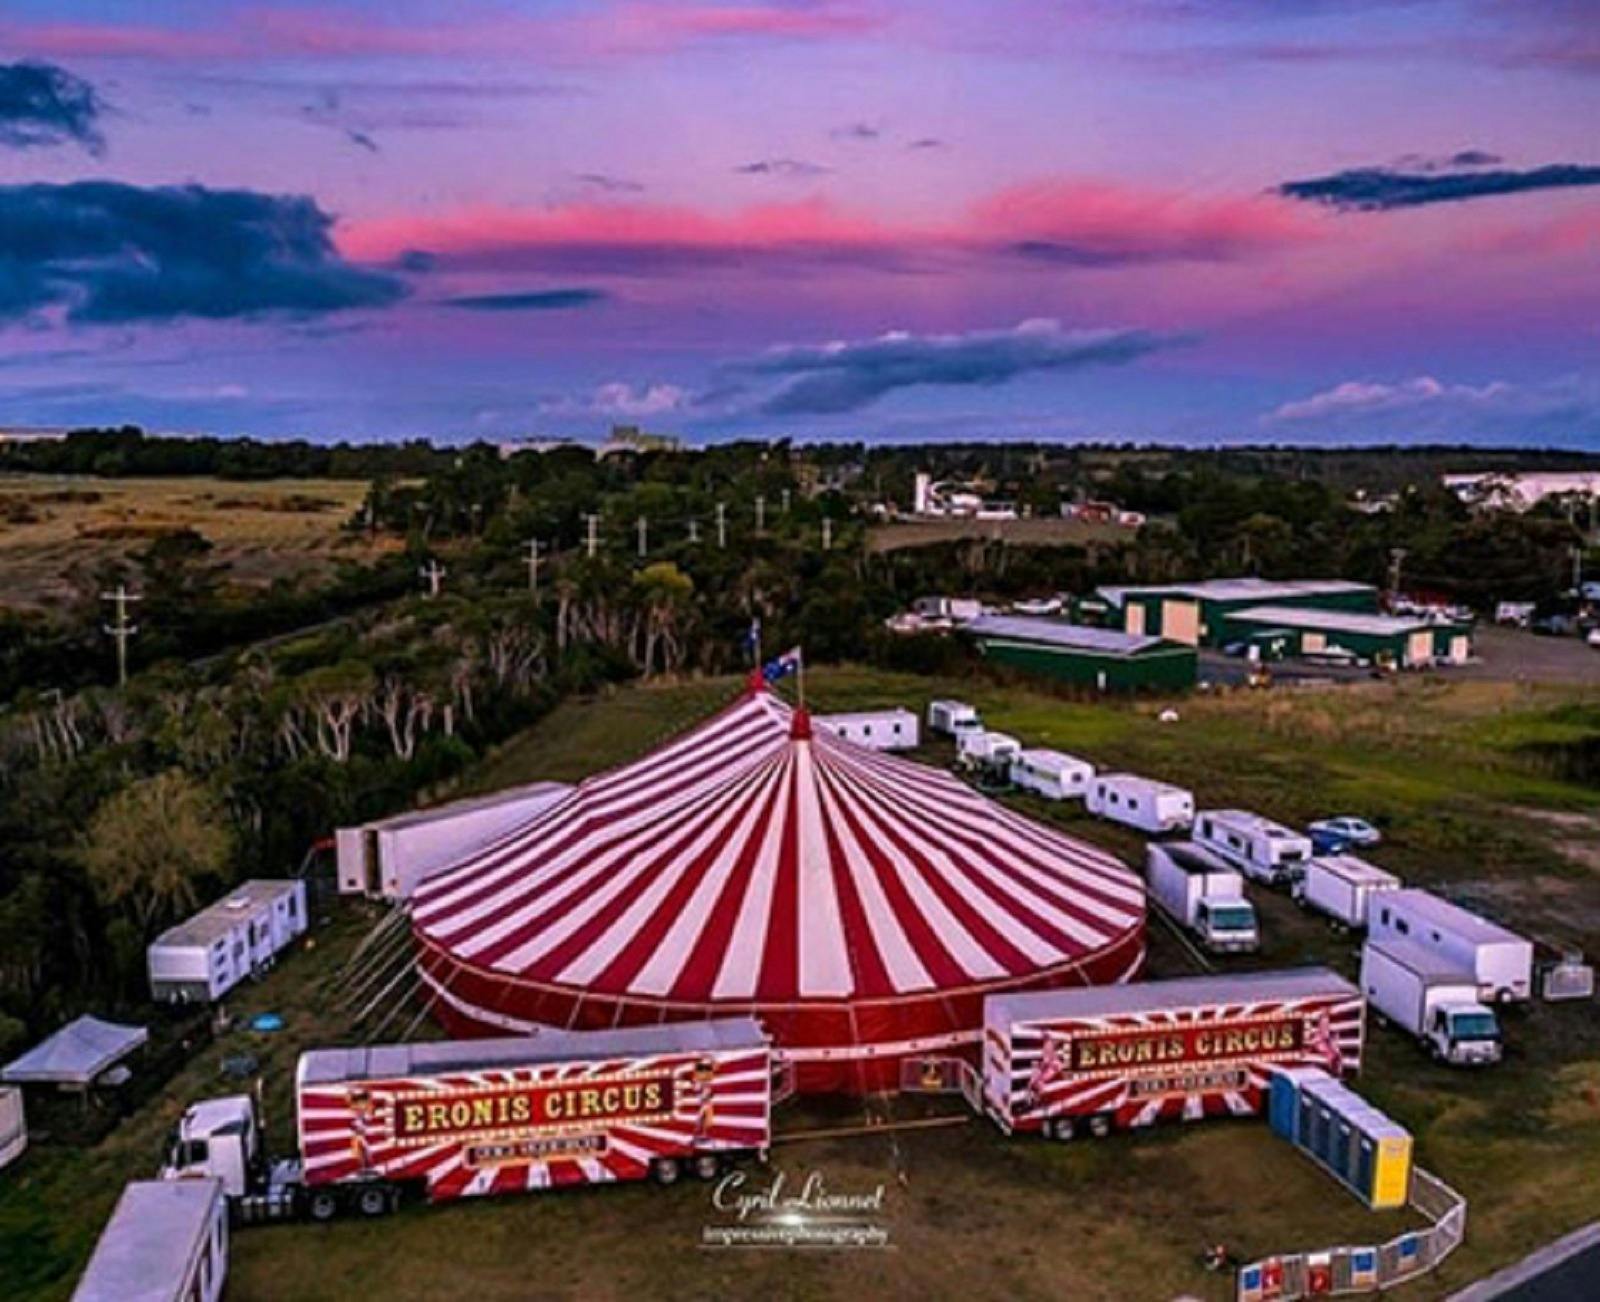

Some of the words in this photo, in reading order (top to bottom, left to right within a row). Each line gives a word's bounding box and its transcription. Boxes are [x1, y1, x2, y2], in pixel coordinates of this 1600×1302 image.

[1080, 1035, 1184, 1066] ERONIS
[1195, 1026, 1293, 1054] CIRCUS
[404, 1095, 530, 1131] ERONIS
[546, 1084, 662, 1117] CIRCUS
